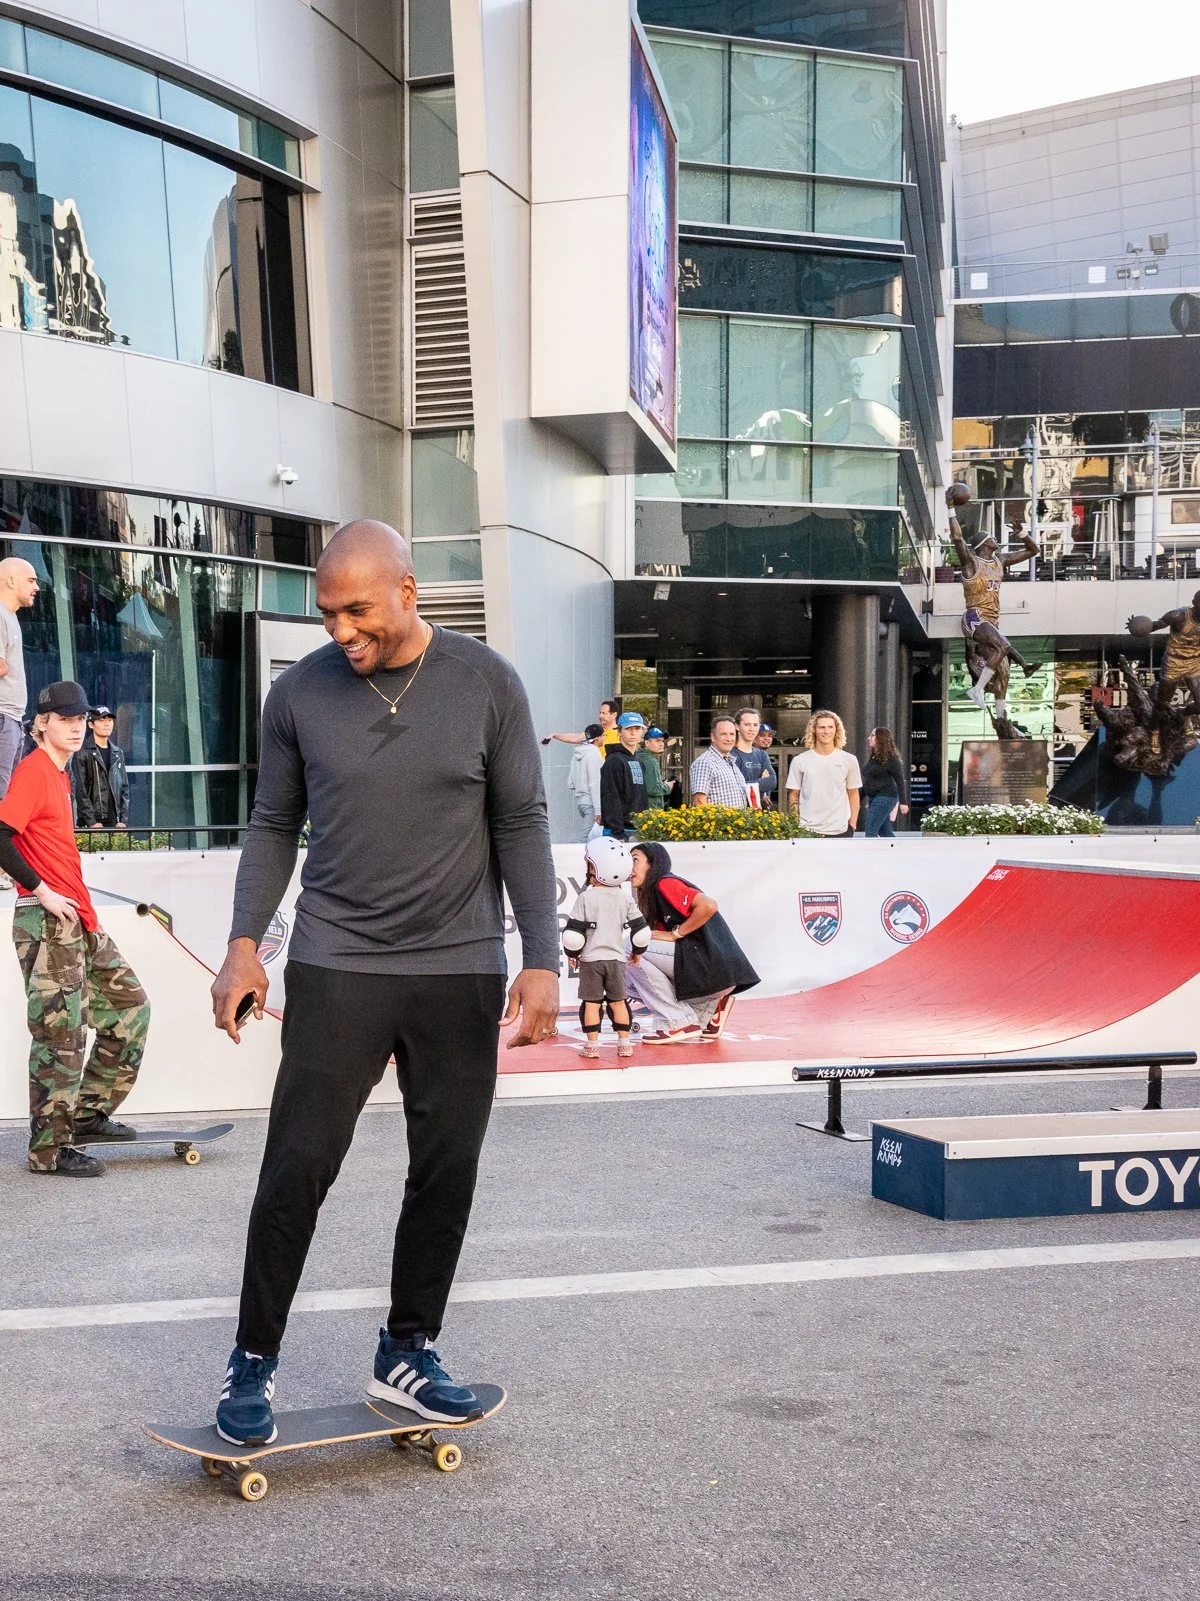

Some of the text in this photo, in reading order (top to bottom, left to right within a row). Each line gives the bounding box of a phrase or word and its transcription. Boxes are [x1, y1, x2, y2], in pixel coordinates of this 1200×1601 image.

[817, 1068, 875, 1078] KEEN RAMPS
[880, 1137, 902, 1154] KEEN
[877, 1150, 902, 1167] RAMPS
[1078, 1156, 1200, 1207] TOY
